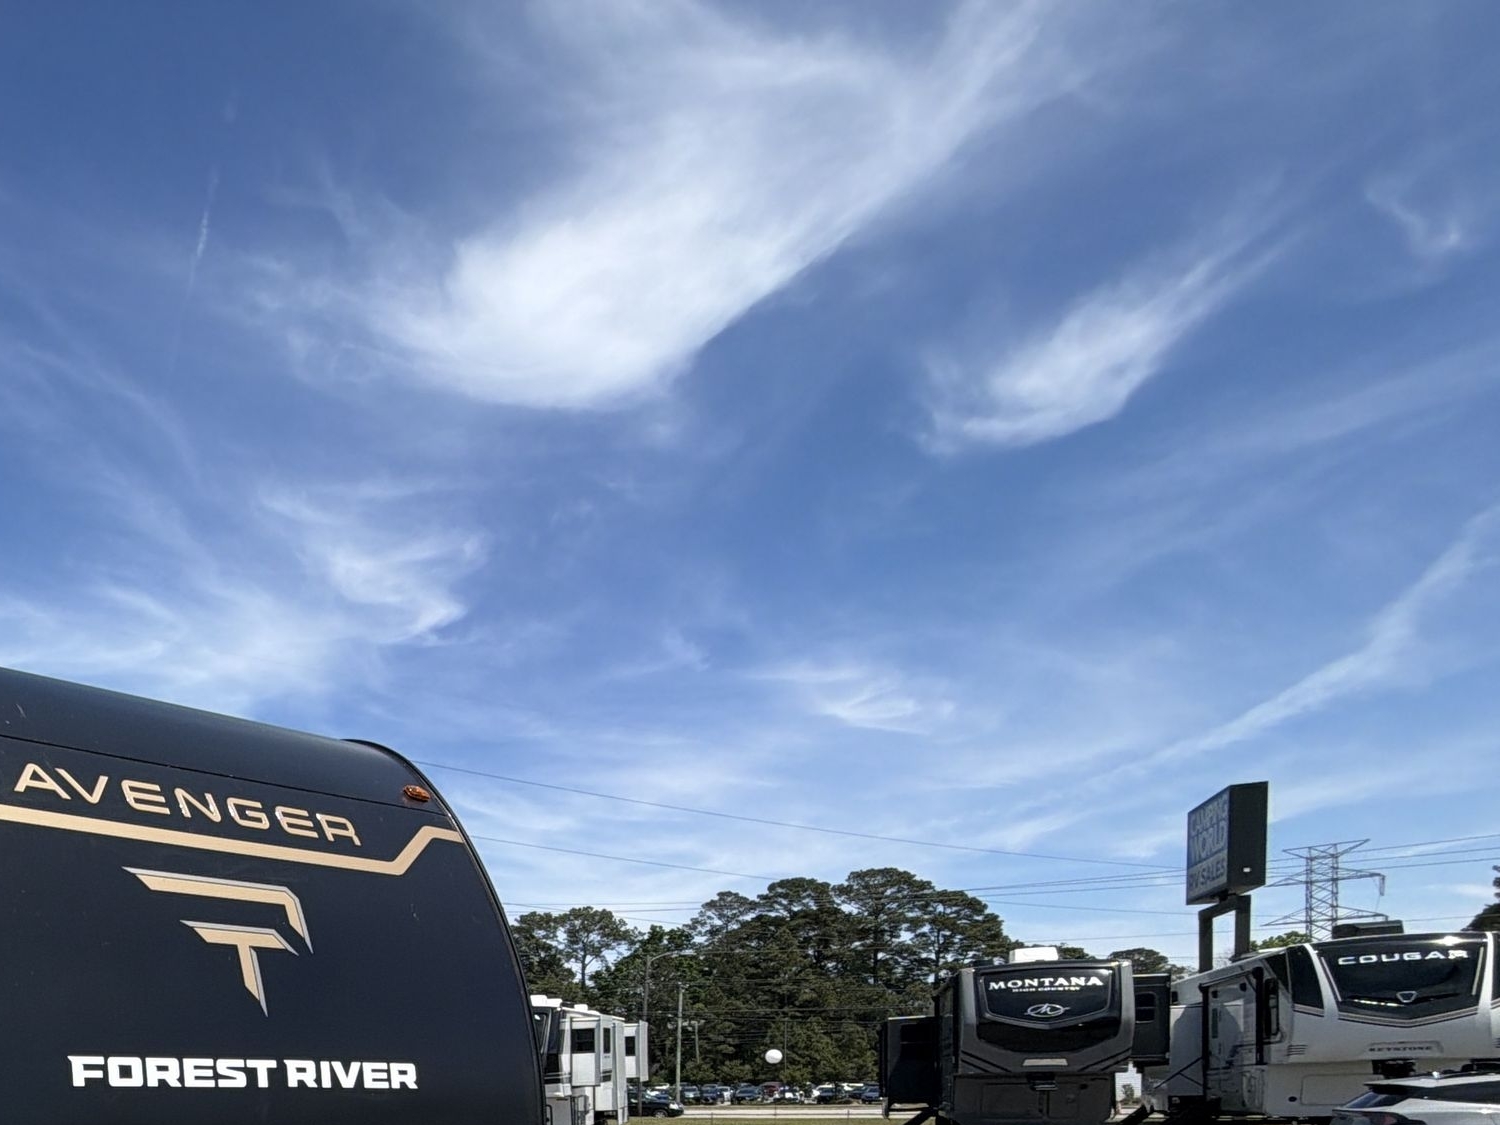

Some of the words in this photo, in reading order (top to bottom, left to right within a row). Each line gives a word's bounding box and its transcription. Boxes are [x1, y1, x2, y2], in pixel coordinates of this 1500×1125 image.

[13, 762, 362, 847] AVENGER
[1190, 821, 1226, 862] WORLD
[1201, 858, 1226, 885] SALES
[1338, 949, 1469, 965] COUGAR
[988, 976, 1104, 990] MONTANA
[67, 1055, 277, 1088] FOREST
[283, 1059, 418, 1089] RIVER
